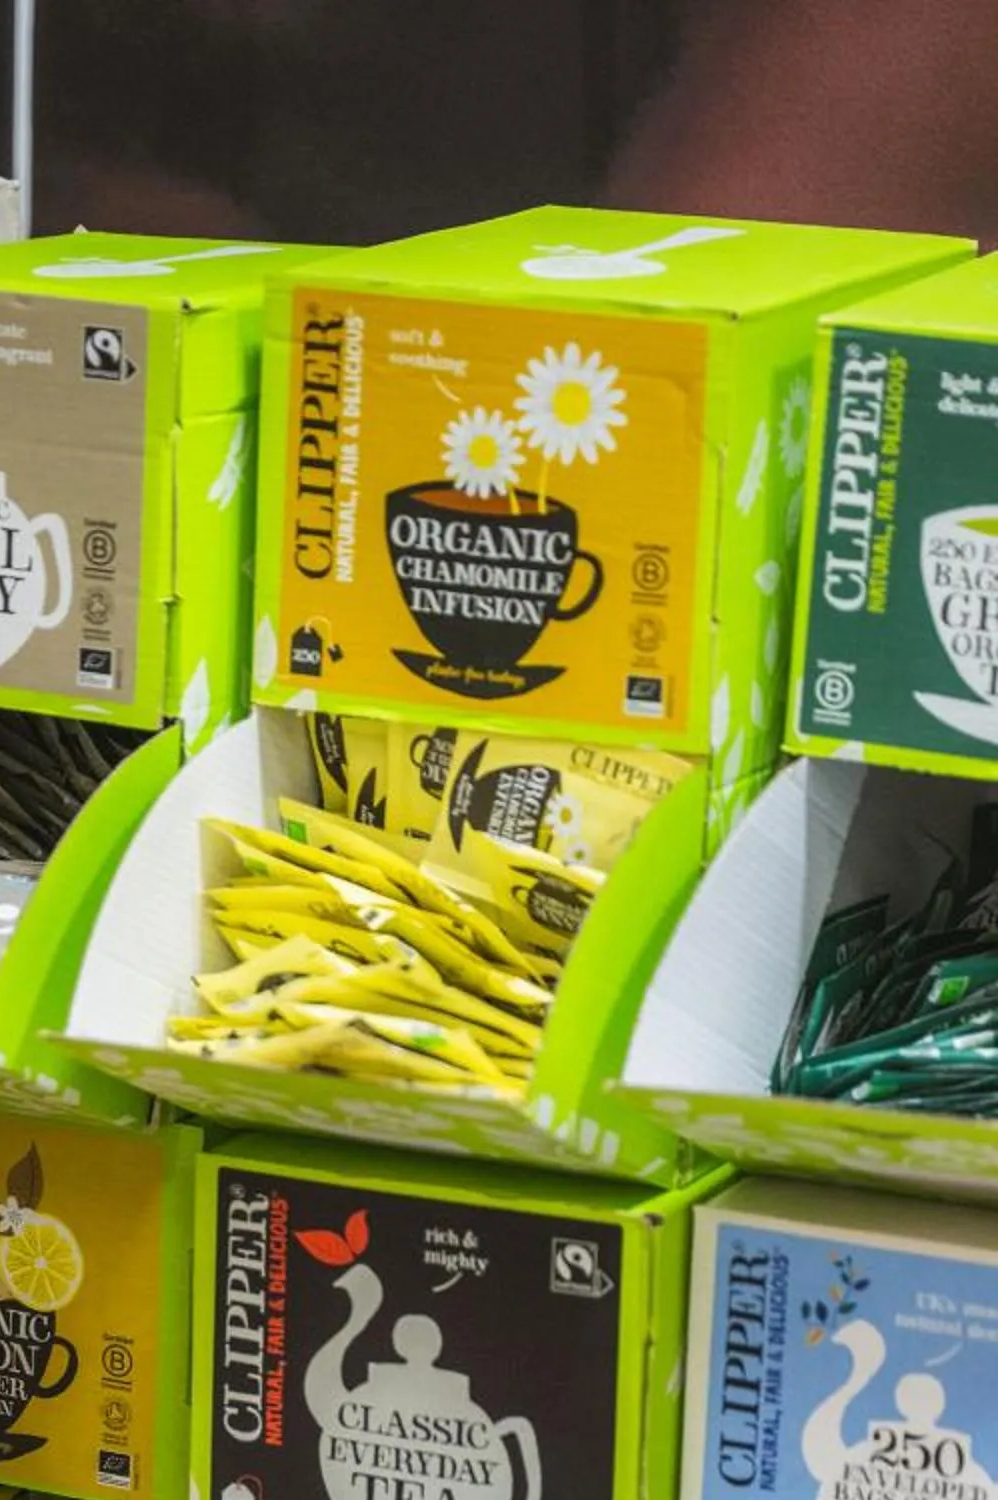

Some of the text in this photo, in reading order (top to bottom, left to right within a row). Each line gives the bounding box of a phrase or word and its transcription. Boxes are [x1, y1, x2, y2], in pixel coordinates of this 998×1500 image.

[295, 311, 345, 580] CLIPPER
[339, 443, 360, 485] FAIR
[823, 352, 888, 611] CLIPPER
[390, 514, 574, 565] ORGANIC
[929, 538, 975, 561] 250
[396, 556, 564, 596] CHAMOMILE
[934, 561, 998, 591] BAG
[410, 587, 546, 626] INFUSION
[267, 1195, 289, 1294] DELICIOUS
[425, 1226, 479, 1249] rich &
[424, 1250, 489, 1277] mighty
[223, 1192, 269, 1443] CLIPPER
[267, 1317, 285, 1355] FAIR
[718, 1248, 770, 1488] CLIPPER
[765, 1368, 782, 1404] FAIR
[338, 1401, 490, 1450] CLASSIC
[328, 1435, 501, 1486] EVERYDAY
[870, 1427, 965, 1478] 250
